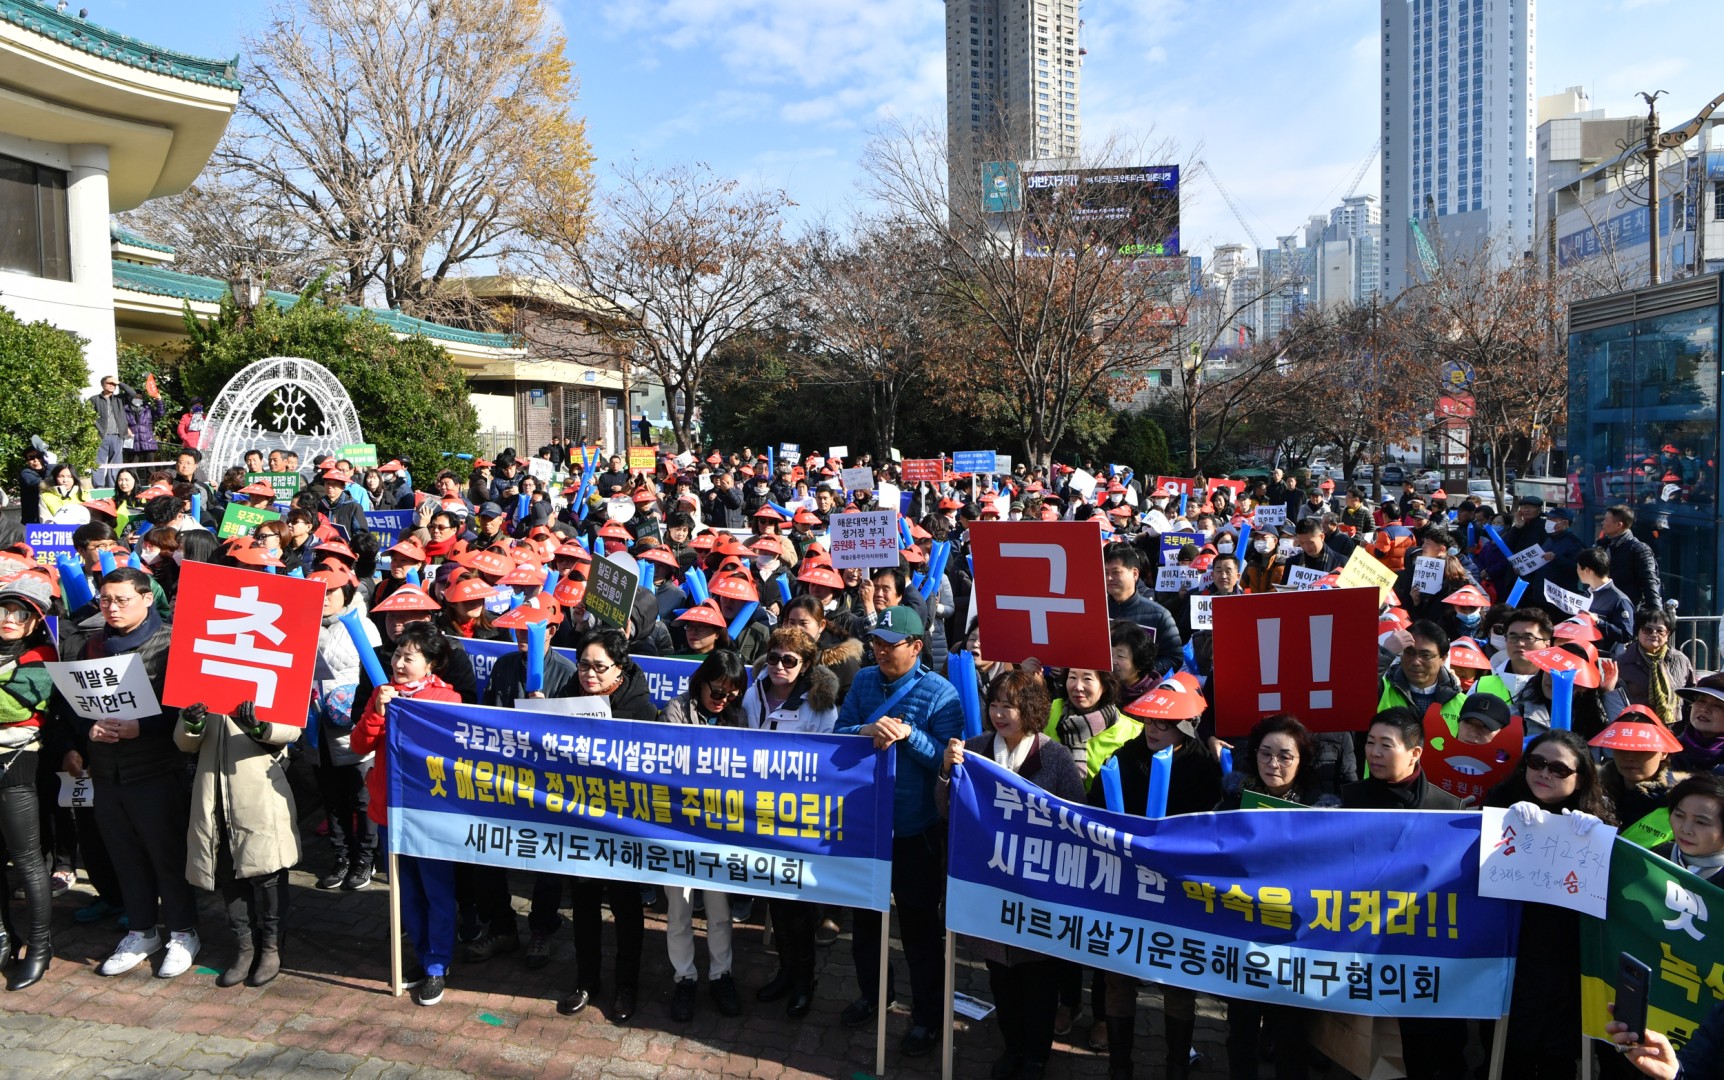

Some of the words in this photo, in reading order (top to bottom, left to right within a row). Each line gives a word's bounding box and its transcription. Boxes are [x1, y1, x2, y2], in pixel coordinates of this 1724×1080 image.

[236, 510, 265, 524] 무조건
[837, 516, 877, 528] 해운대역사
[880, 515, 889, 526] 및
[832, 540, 856, 551] 공원화
[860, 539, 876, 550] 적극
[879, 538, 896, 549] 추진
[842, 528, 865, 539] 정거장
[869, 527, 885, 537] 부지
[1164, 535, 1195, 546] 국토부는
[1424, 559, 1441, 571] 소원은
[596, 580, 622, 606] 주민들의
[995, 542, 1085, 645] 구
[585, 591, 611, 617] 쉼터공간
[611, 609, 626, 626] 확보
[880, 611, 894, 629] A
[193, 585, 294, 709] 축
[1256, 614, 1334, 711] !!
[69, 667, 120, 689] 개발을
[75, 691, 138, 714] 금지한다
[1604, 727, 1661, 742] 공원화!
[453, 721, 539, 763] 국토교통부,
[542, 733, 690, 776] 한국철도시설공단에
[697, 747, 747, 781] 보내는
[752, 748, 819, 783] 메시지!!
[426, 755, 448, 798] 옛
[456, 757, 536, 809] 해운대역
[545, 770, 673, 824] 정거장부지를
[681, 786, 745, 834] 주민의
[756, 790, 844, 841] 품으로!!
[464, 822, 805, 890] 새마을지도자해운대구협의회
[988, 831, 1123, 898] 시민에게
[1135, 862, 1169, 904] 한
[1182, 881, 1294, 931] 약속을
[1308, 888, 1459, 940] 지켜라!!
[1001, 899, 1442, 1004] 바르게살기운동해운대구협의회
